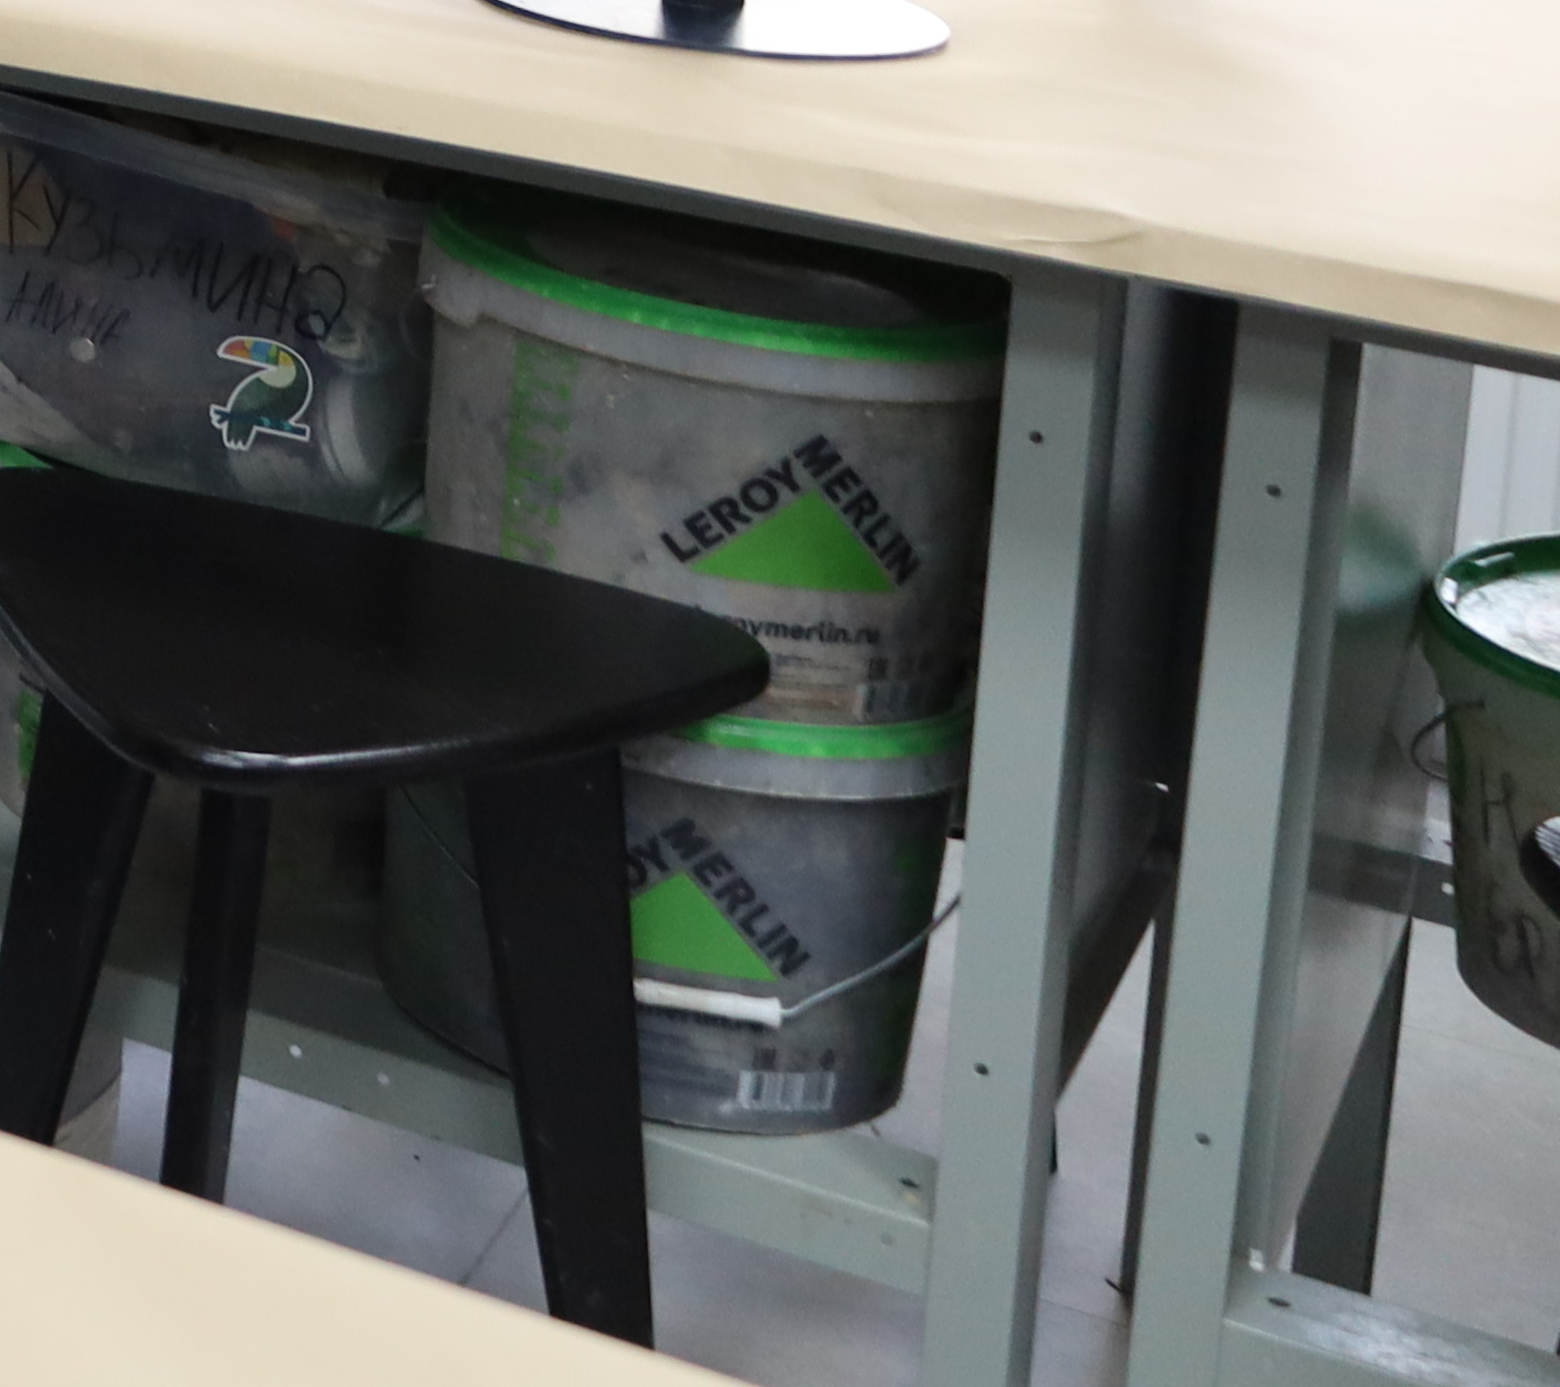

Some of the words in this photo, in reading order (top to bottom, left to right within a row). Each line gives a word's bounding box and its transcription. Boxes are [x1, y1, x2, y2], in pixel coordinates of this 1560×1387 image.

[660, 456, 802, 563] LEROY
[793, 433, 922, 587] MERLIN
[660, 817, 811, 977] MERLIN
